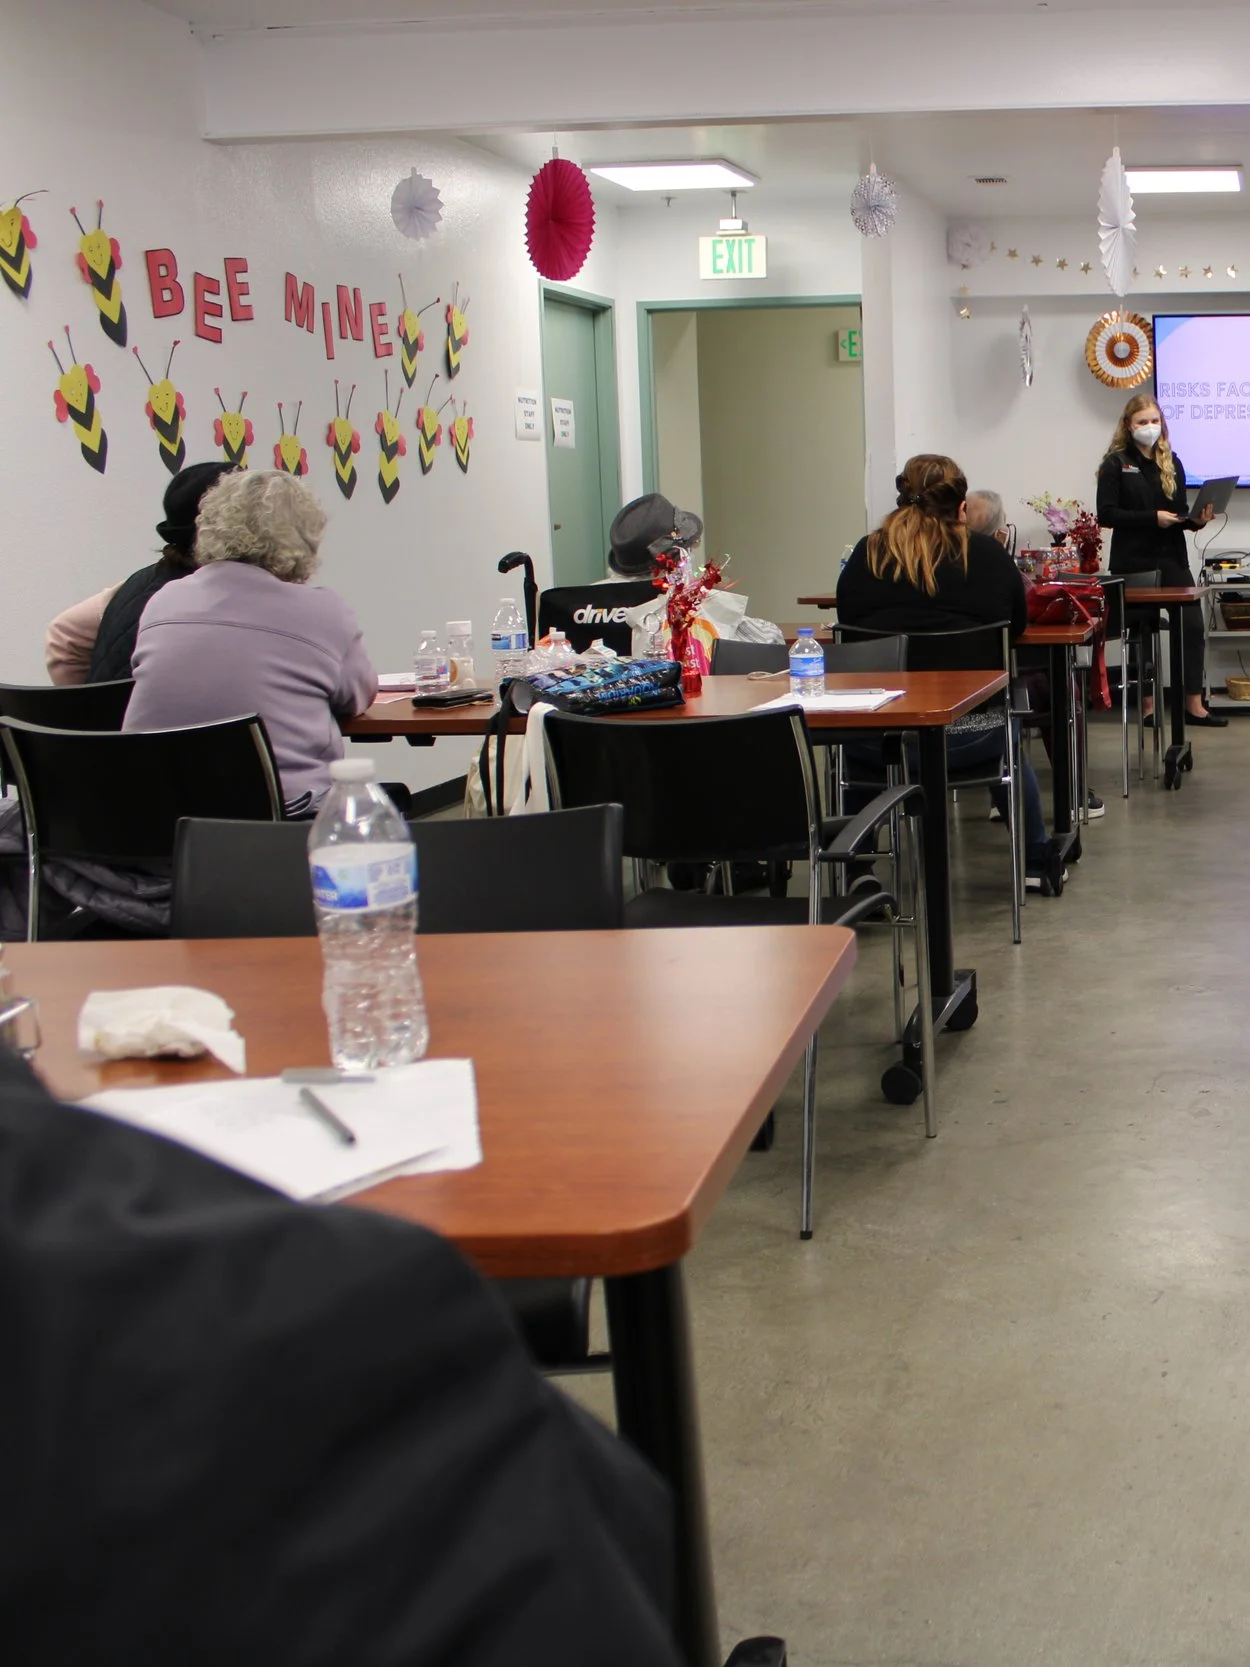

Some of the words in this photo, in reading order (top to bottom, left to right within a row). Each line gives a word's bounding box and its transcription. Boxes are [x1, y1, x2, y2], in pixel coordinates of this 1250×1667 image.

[712, 238, 756, 274] EXIT
[145, 248, 254, 344] BEE
[284, 271, 393, 360] MINE
[848, 330, 863, 357] E
[1159, 382, 1211, 398] RISKS
[1161, 404, 1185, 420] OF
[573, 604, 628, 624] drive
